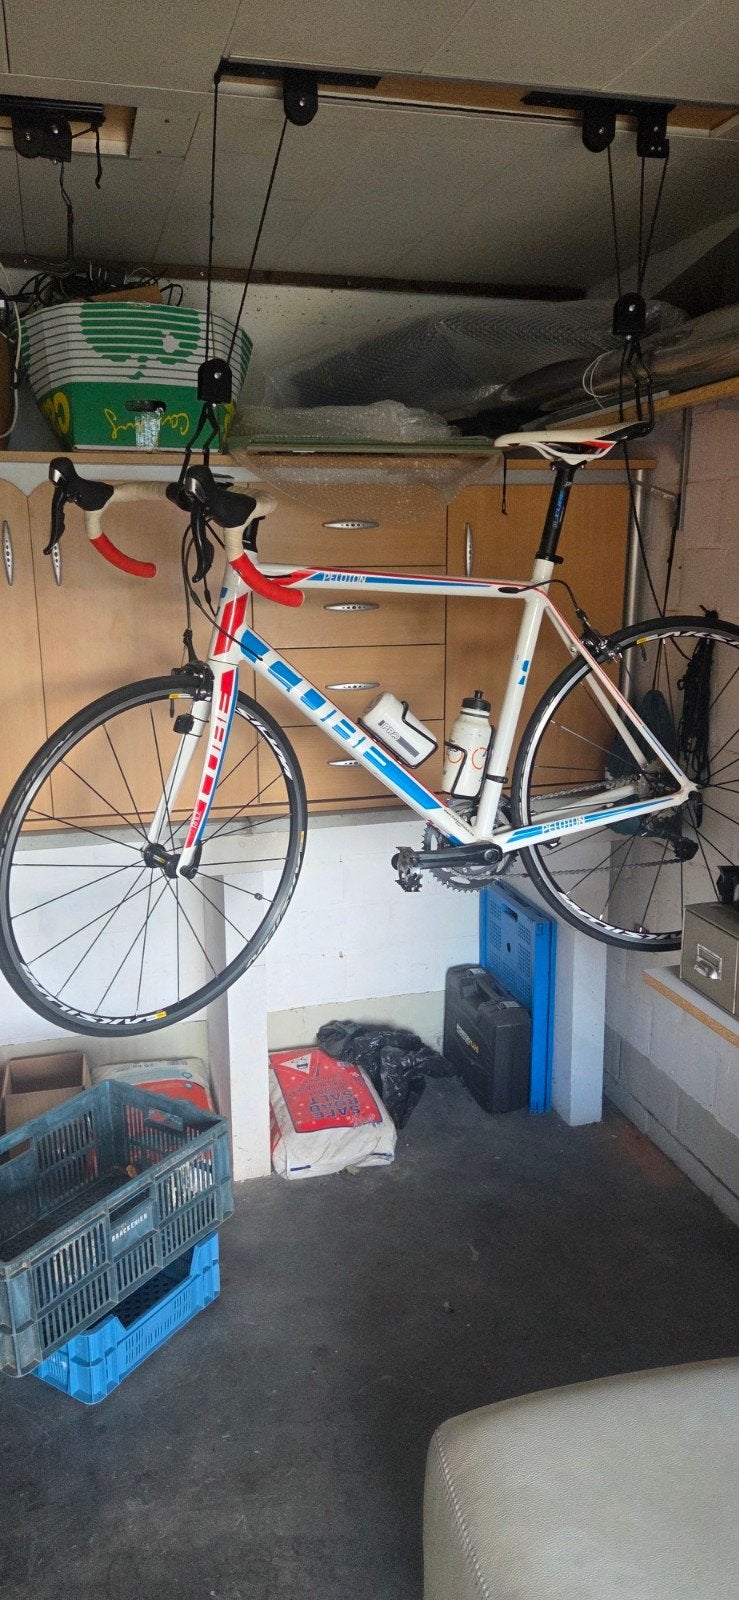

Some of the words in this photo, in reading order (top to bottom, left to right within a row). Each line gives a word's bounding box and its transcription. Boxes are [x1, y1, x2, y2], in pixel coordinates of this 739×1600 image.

[323, 571, 366, 583] PELOTON
[256, 646, 391, 768] CUBE
[542, 815, 585, 834] PELOTON
[309, 1089, 355, 1106] SALT
[312, 1104, 360, 1119] SAFE
